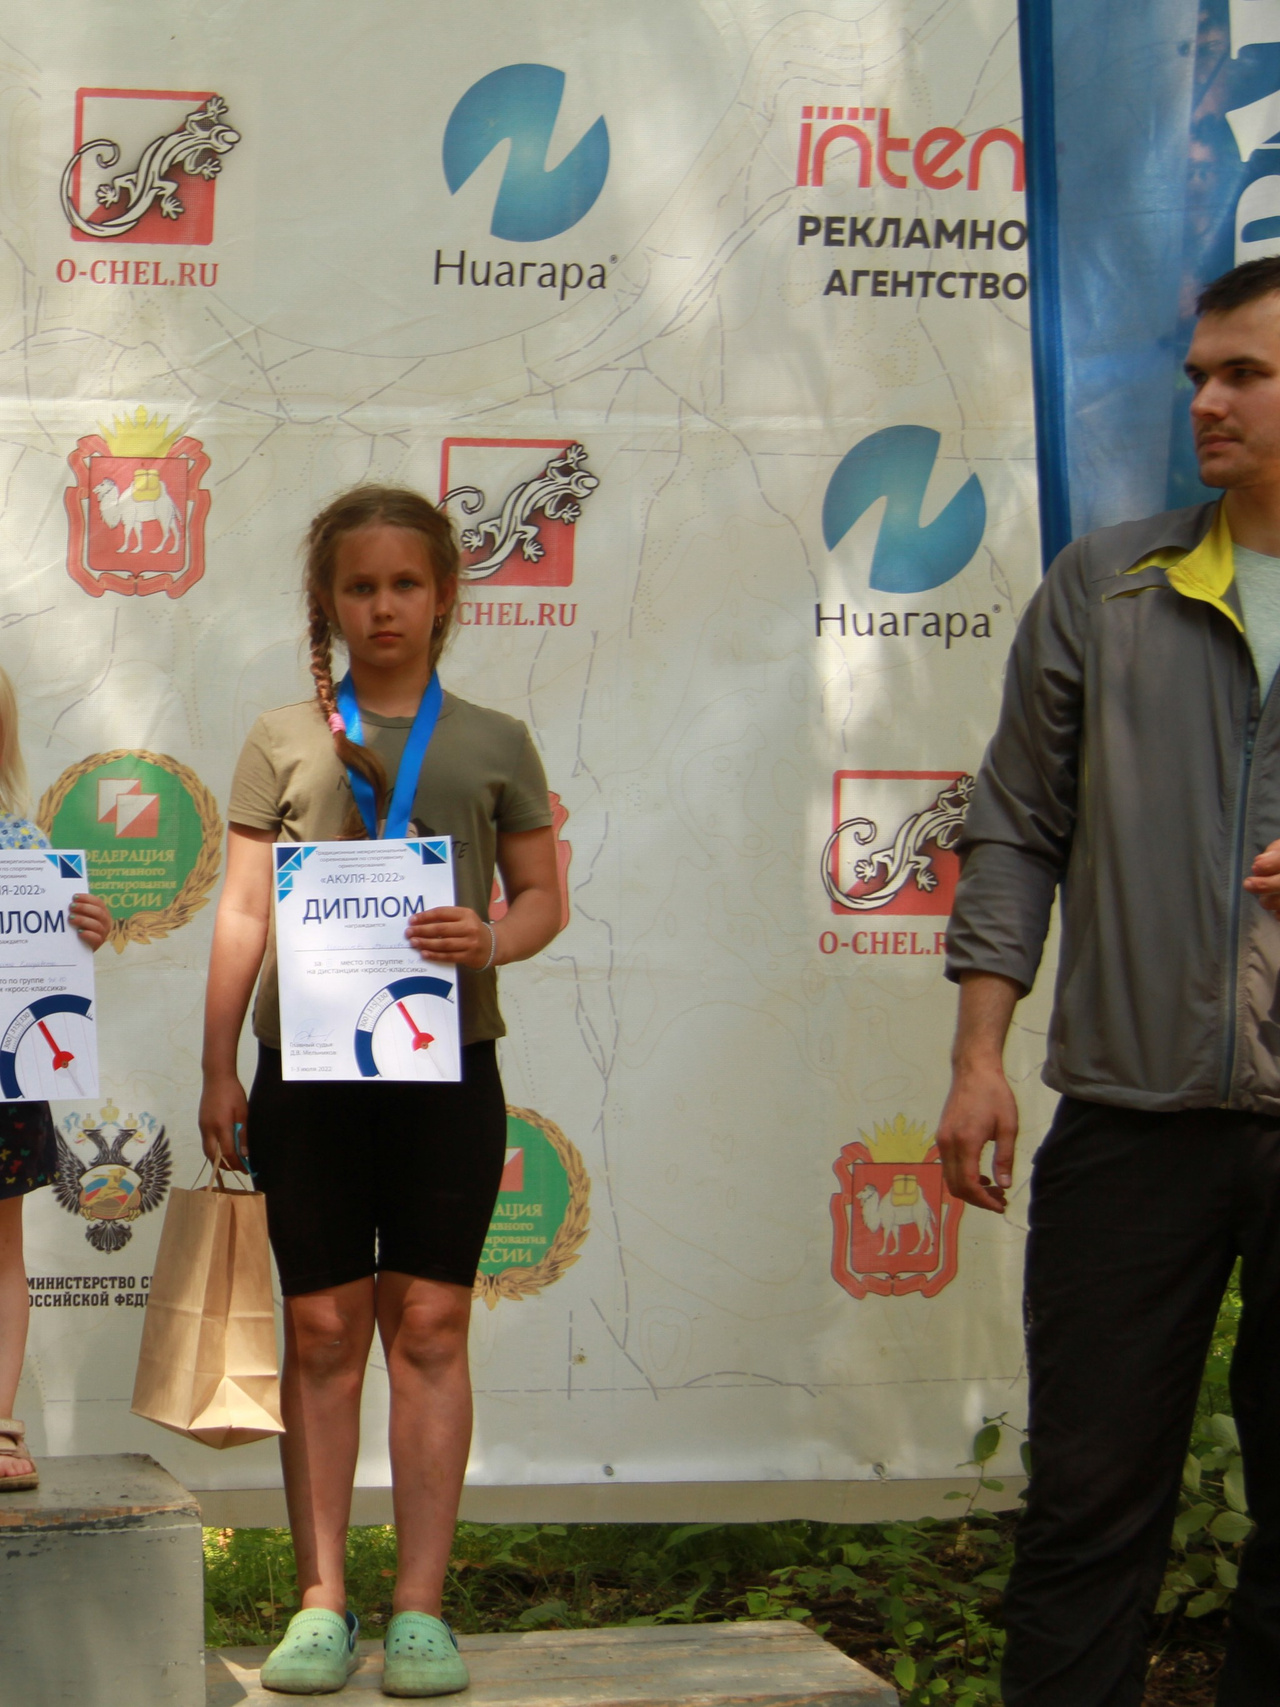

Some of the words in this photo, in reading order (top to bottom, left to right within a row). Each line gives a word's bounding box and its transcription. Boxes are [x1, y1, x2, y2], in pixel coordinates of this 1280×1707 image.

[796, 105, 1026, 191] inten
[797, 215, 1027, 251] РЕКЛАМНО
[56, 258, 219, 287] O-CHEL.RU
[823, 269, 1027, 300] АГЕНТСТВО
[456, 602, 578, 627] CHEL.RU
[320, 872, 405, 884] «АКУЛЯ-2022»
[302, 895, 425, 925] ДИПЛОМ
[818, 931, 948, 955] O-CHEL.R
[480, 1248, 533, 1263] ССИИ
[29, 1291, 109, 1307] ОССИЙСКОЙ
